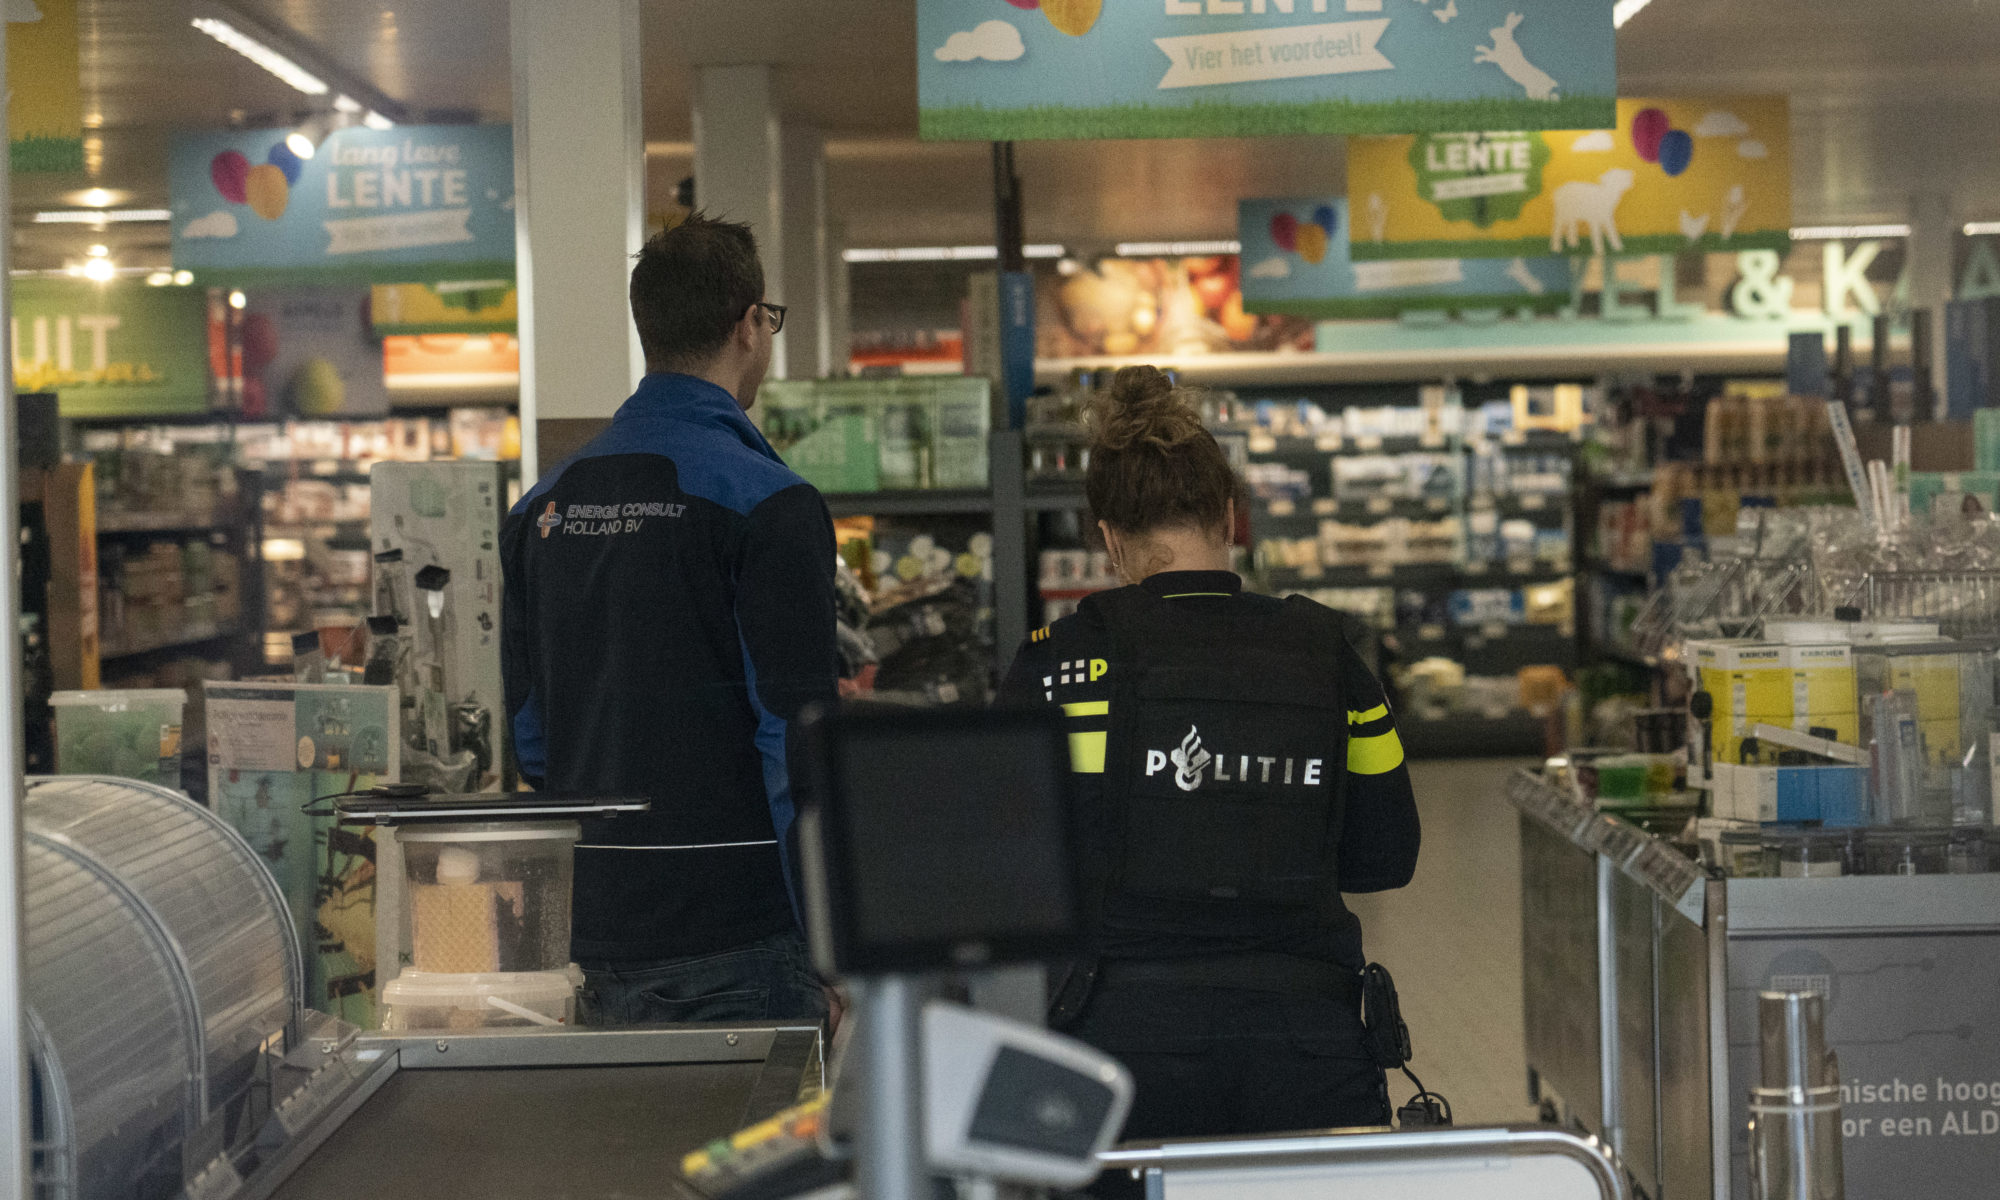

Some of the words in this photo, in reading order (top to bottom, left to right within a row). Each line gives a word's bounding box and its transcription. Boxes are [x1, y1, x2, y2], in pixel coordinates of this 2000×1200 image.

[1184, 45, 1224, 72] Vier
[1230, 41, 1264, 67] het
[1268, 31, 1362, 64] voordeel!
[1426, 140, 1532, 172] LENTE
[326, 168, 469, 208] LENTE
[621, 502, 687, 517] CONSULT
[562, 520, 622, 535] HOLLAND
[625, 518, 644, 533] BV
[1089, 658, 1108, 681] P
[1841, 1116, 1872, 1138] or
[1880, 1115, 1932, 1137] een
[1940, 1109, 2000, 1136] ALD
